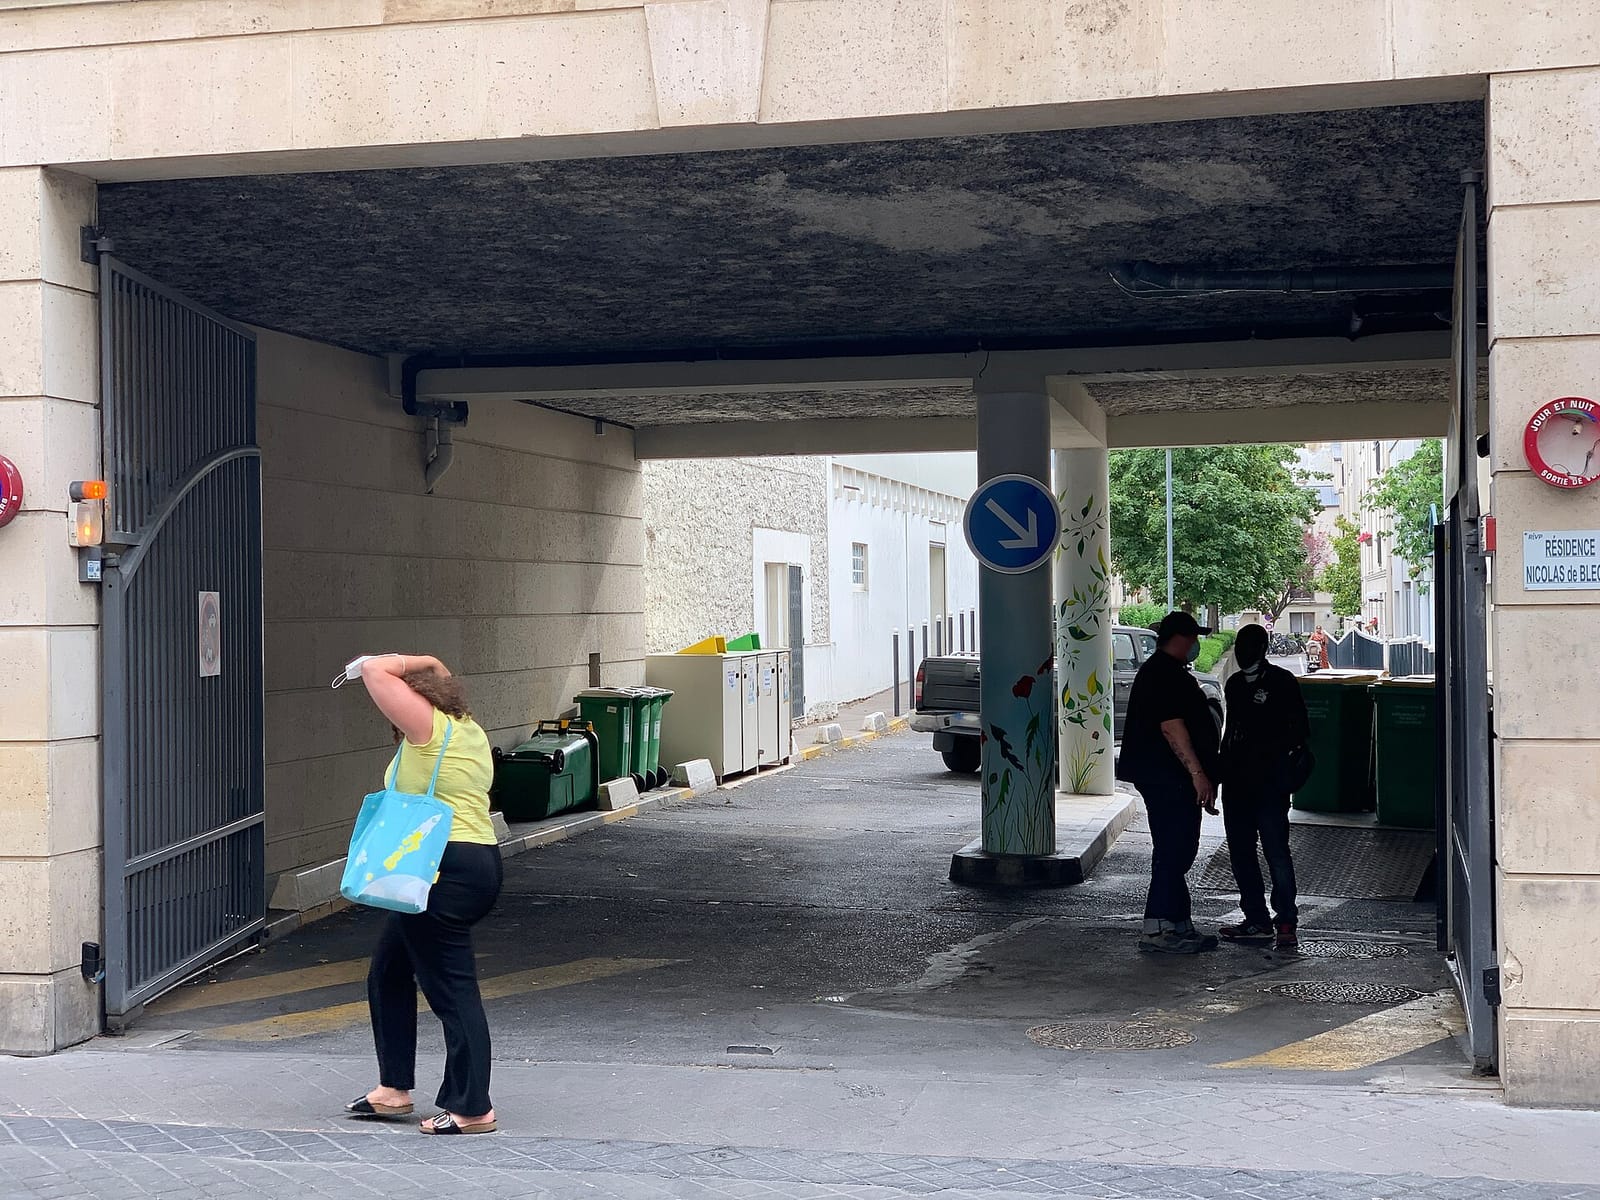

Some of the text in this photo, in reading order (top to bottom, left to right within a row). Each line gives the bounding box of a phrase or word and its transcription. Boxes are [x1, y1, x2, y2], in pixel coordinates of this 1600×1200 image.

[1530, 400, 1595, 432] JOUR ET NUIT
[1540, 469, 1569, 486] SORTIE
[1572, 477, 1584, 486] DE
[1545, 535, 1596, 556] RÉSIDENCE
[1526, 565, 1565, 583] NICOLAS
[1567, 565, 1578, 582] de
